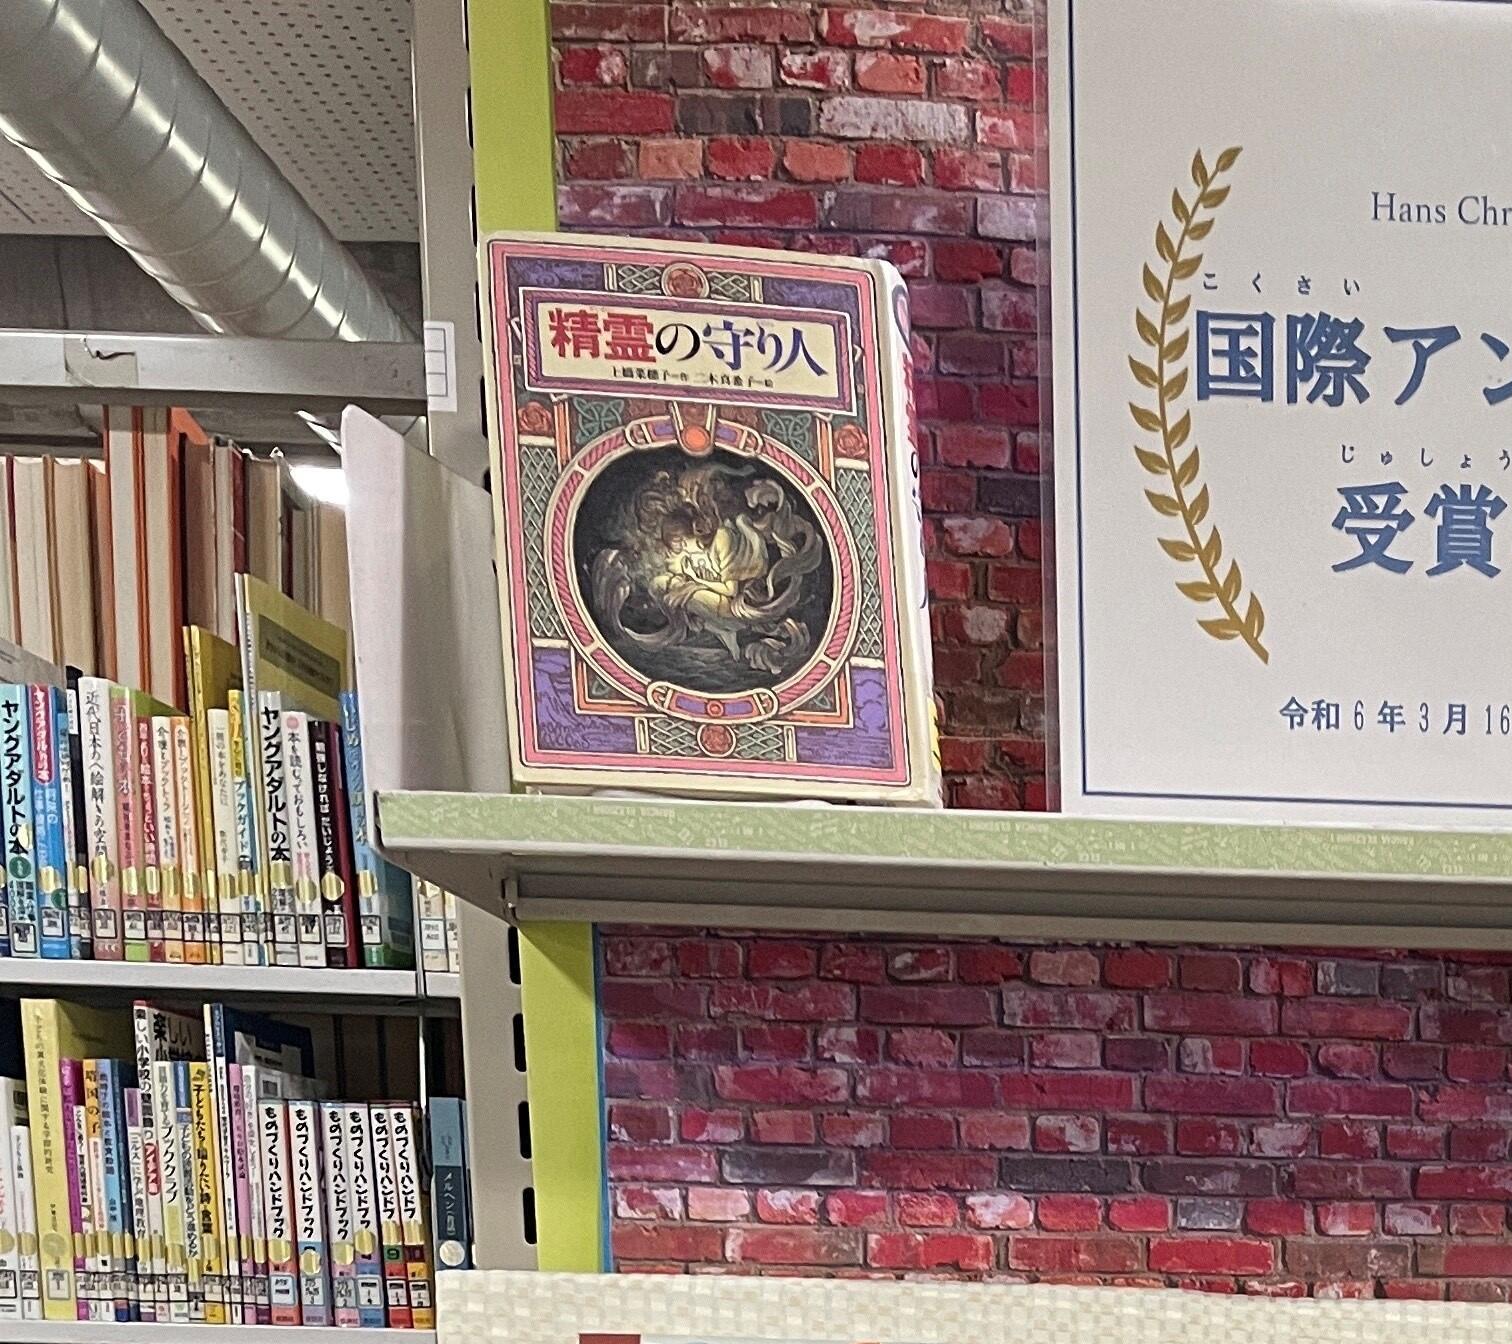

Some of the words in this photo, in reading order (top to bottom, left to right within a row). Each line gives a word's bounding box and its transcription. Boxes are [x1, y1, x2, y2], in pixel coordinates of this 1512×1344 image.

[1372, 192, 1447, 225] Hans
[548, 308, 829, 377] 精霊の守り人
[1203, 274, 1361, 297] こくさい
[1, 700, 28, 854] ヤングアダルトの本
[261, 706, 290, 861] ヤングアダルトの本
[264, 1107, 285, 1239] ものづくりハンドブック
[295, 1109, 315, 1239] ものづくりハンドブック
[328, 1110, 348, 1240] ものづくりハンドブック
[349, 1111, 371, 1229] ものづくりハンドブッ
